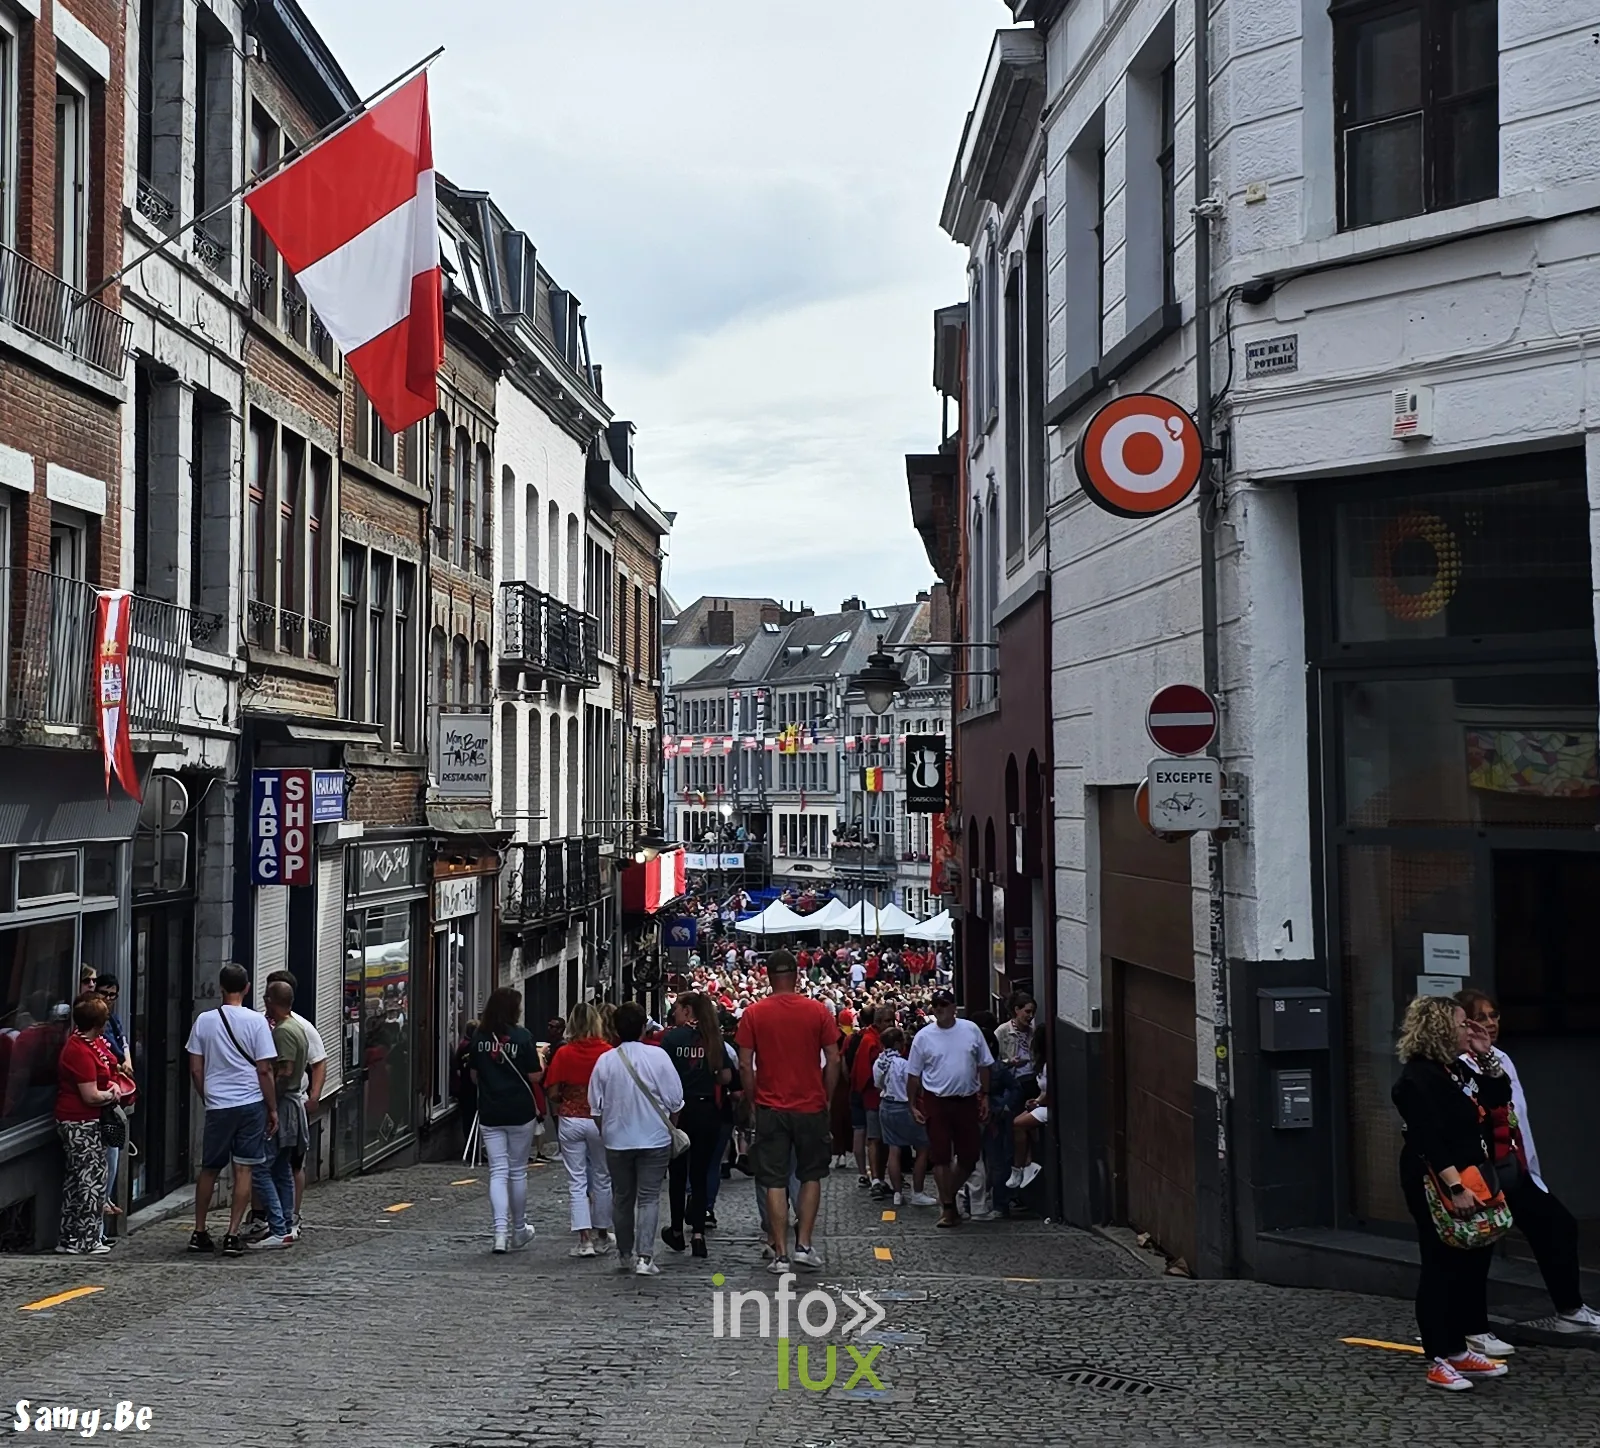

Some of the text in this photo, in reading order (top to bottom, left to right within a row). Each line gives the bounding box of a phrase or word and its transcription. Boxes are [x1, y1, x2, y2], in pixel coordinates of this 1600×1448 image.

[1249, 342, 1294, 358] RUE DE LA
[1254, 354, 1293, 369] POTERIE
[460, 733, 489, 751] Bar
[442, 749, 487, 767] TAPAS
[441, 772, 487, 783] RESTAURANT
[1156, 772, 1213, 784] EXCEPTE
[258, 777, 278, 879] TABAC
[285, 776, 305, 880] SHOP
[1282, 919, 1293, 942] 1
